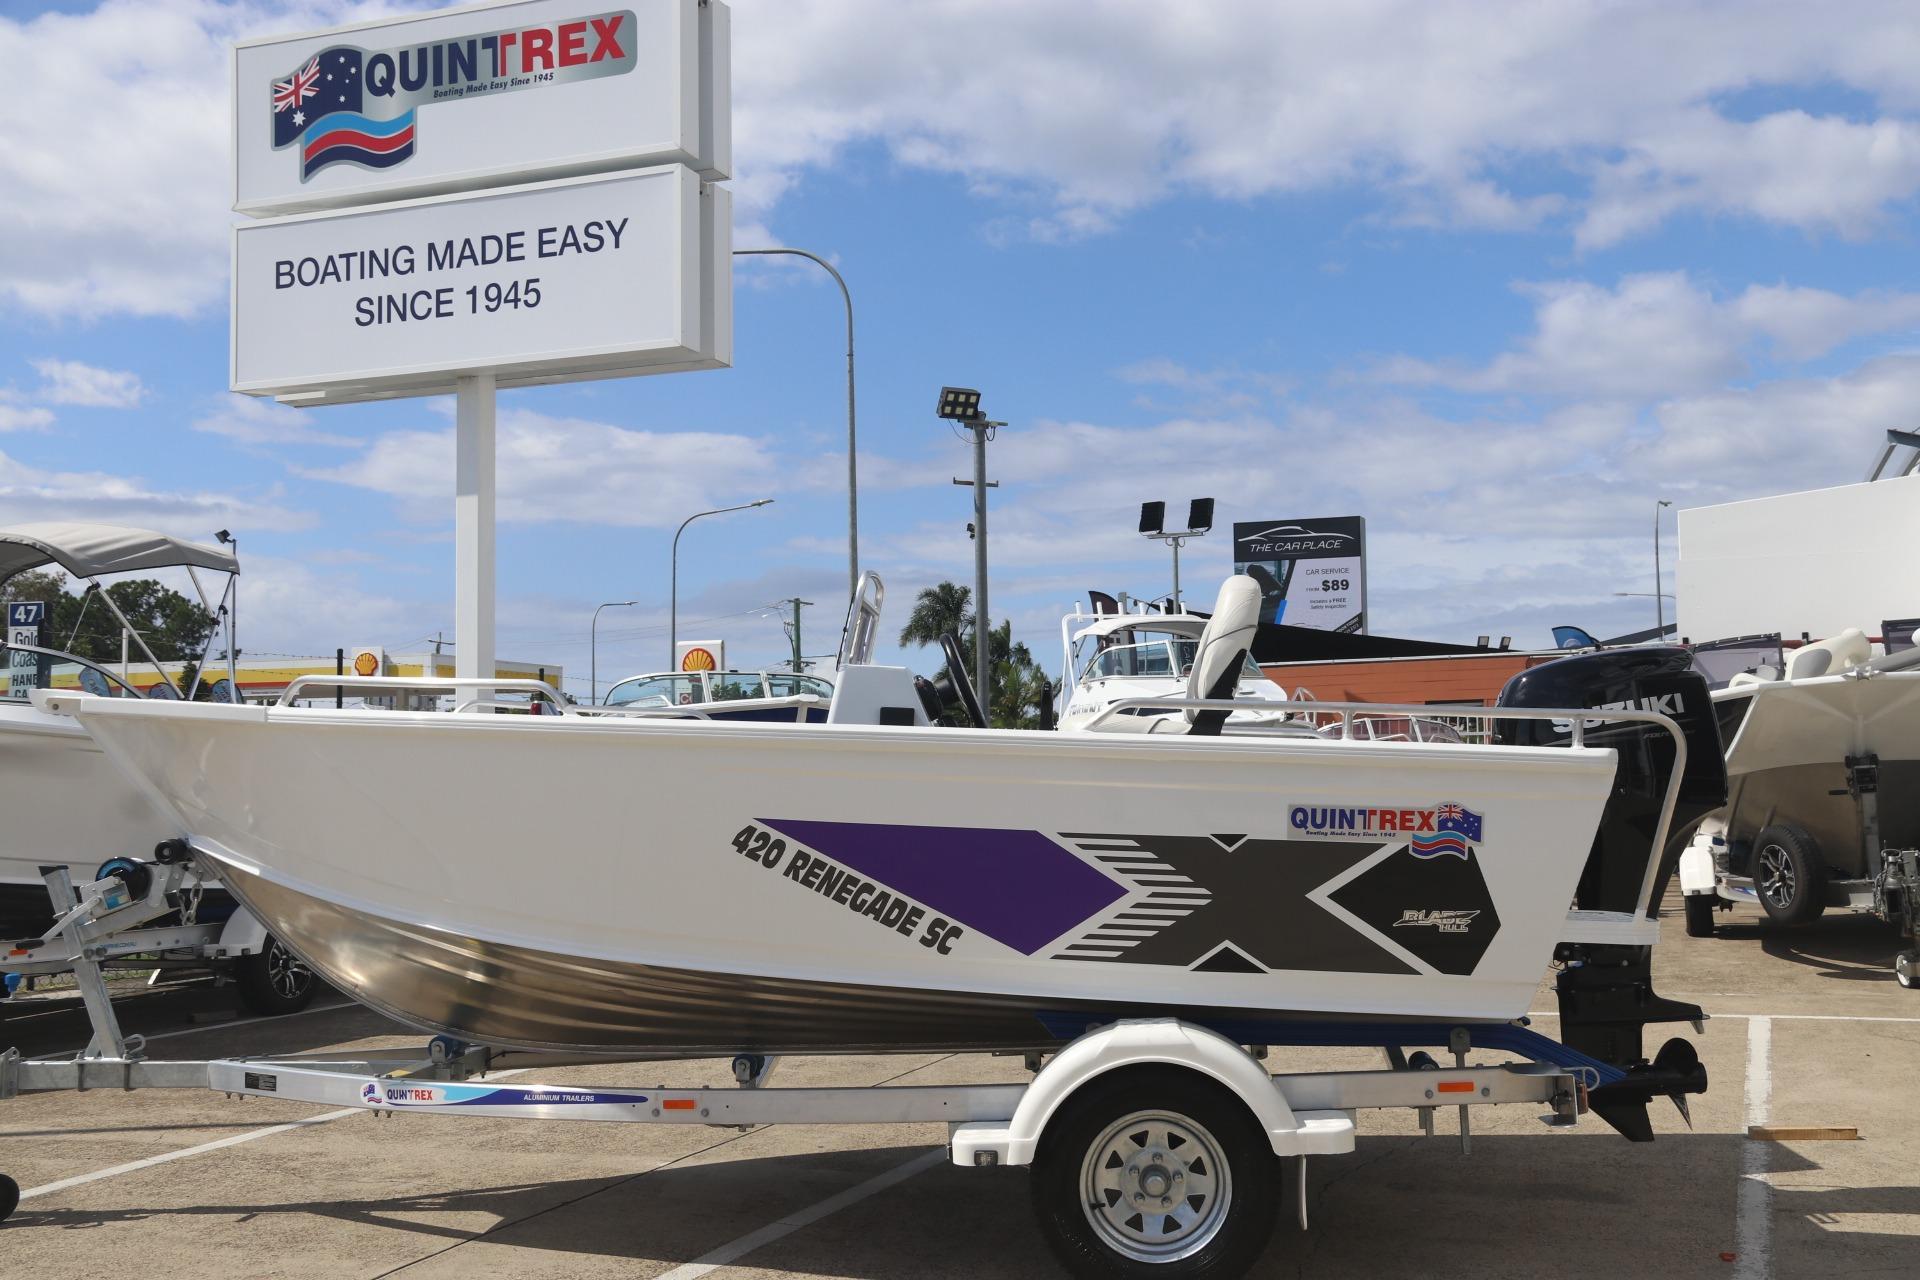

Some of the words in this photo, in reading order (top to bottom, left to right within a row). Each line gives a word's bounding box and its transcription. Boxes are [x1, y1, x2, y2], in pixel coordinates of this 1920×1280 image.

[365, 15, 627, 98] QUINTREX
[433, 87, 464, 98] Boating
[466, 83, 488, 93] Made
[490, 80, 508, 90] Easy
[510, 76, 530, 87] Since
[533, 72, 554, 83] 1945
[274, 244, 416, 290] BOATING
[427, 231, 526, 272] MADE
[538, 217, 629, 259] EASY
[354, 287, 454, 327] SINCE
[465, 278, 542, 315] 1945
[1250, 543, 1274, 552] THE
[1274, 541, 1301, 551] CAR
[1302, 539, 1343, 550] PLACE
[1321, 567, 1350, 575] SERVICE
[1322, 579, 1350, 592] $89
[14, 605, 38, 623] 47
[12, 650, 38, 668] Coas
[15, 689, 28, 699] CA
[1290, 806, 1436, 832] QUINTREX
[731, 825, 787, 869] 420
[782, 849, 926, 938] RENEGADE
[918, 917, 964, 956] SC
[1393, 909, 1481, 927] BLADE
[387, 1088, 433, 1101] QUINTREX
[523, 1093, 560, 1101] ALUMINIUM
